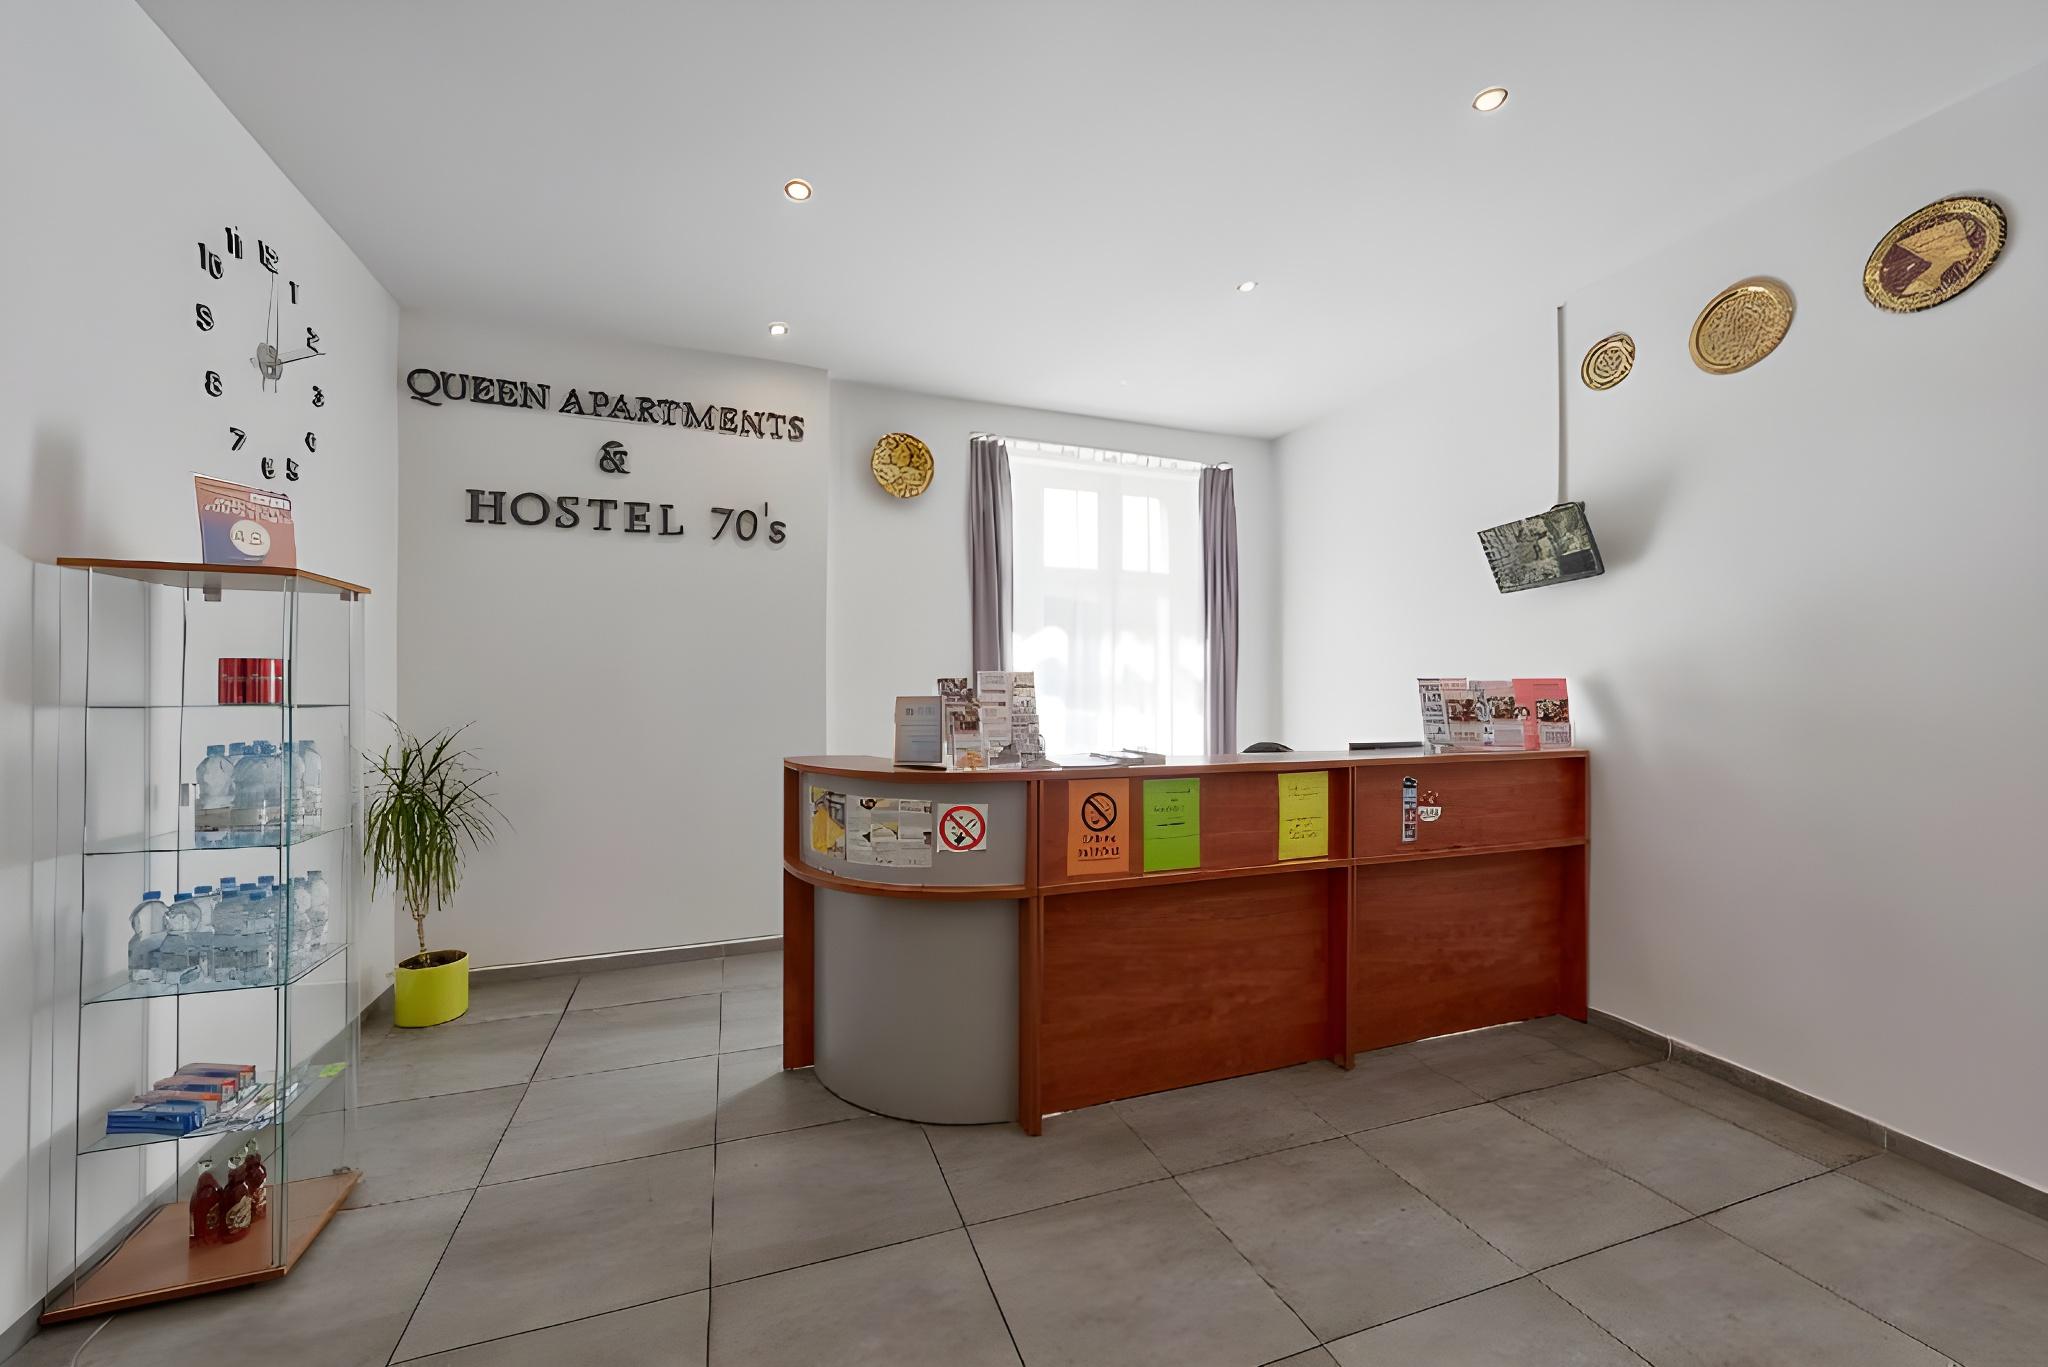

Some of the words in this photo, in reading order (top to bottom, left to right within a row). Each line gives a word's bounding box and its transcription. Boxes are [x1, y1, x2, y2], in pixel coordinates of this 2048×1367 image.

[406, 368, 552, 410] QUEEN
[557, 388, 805, 442] APARTMENTS
[229, 427, 247, 451] 7
[598, 440, 631, 474] &
[464, 488, 685, 536] HOSTEL
